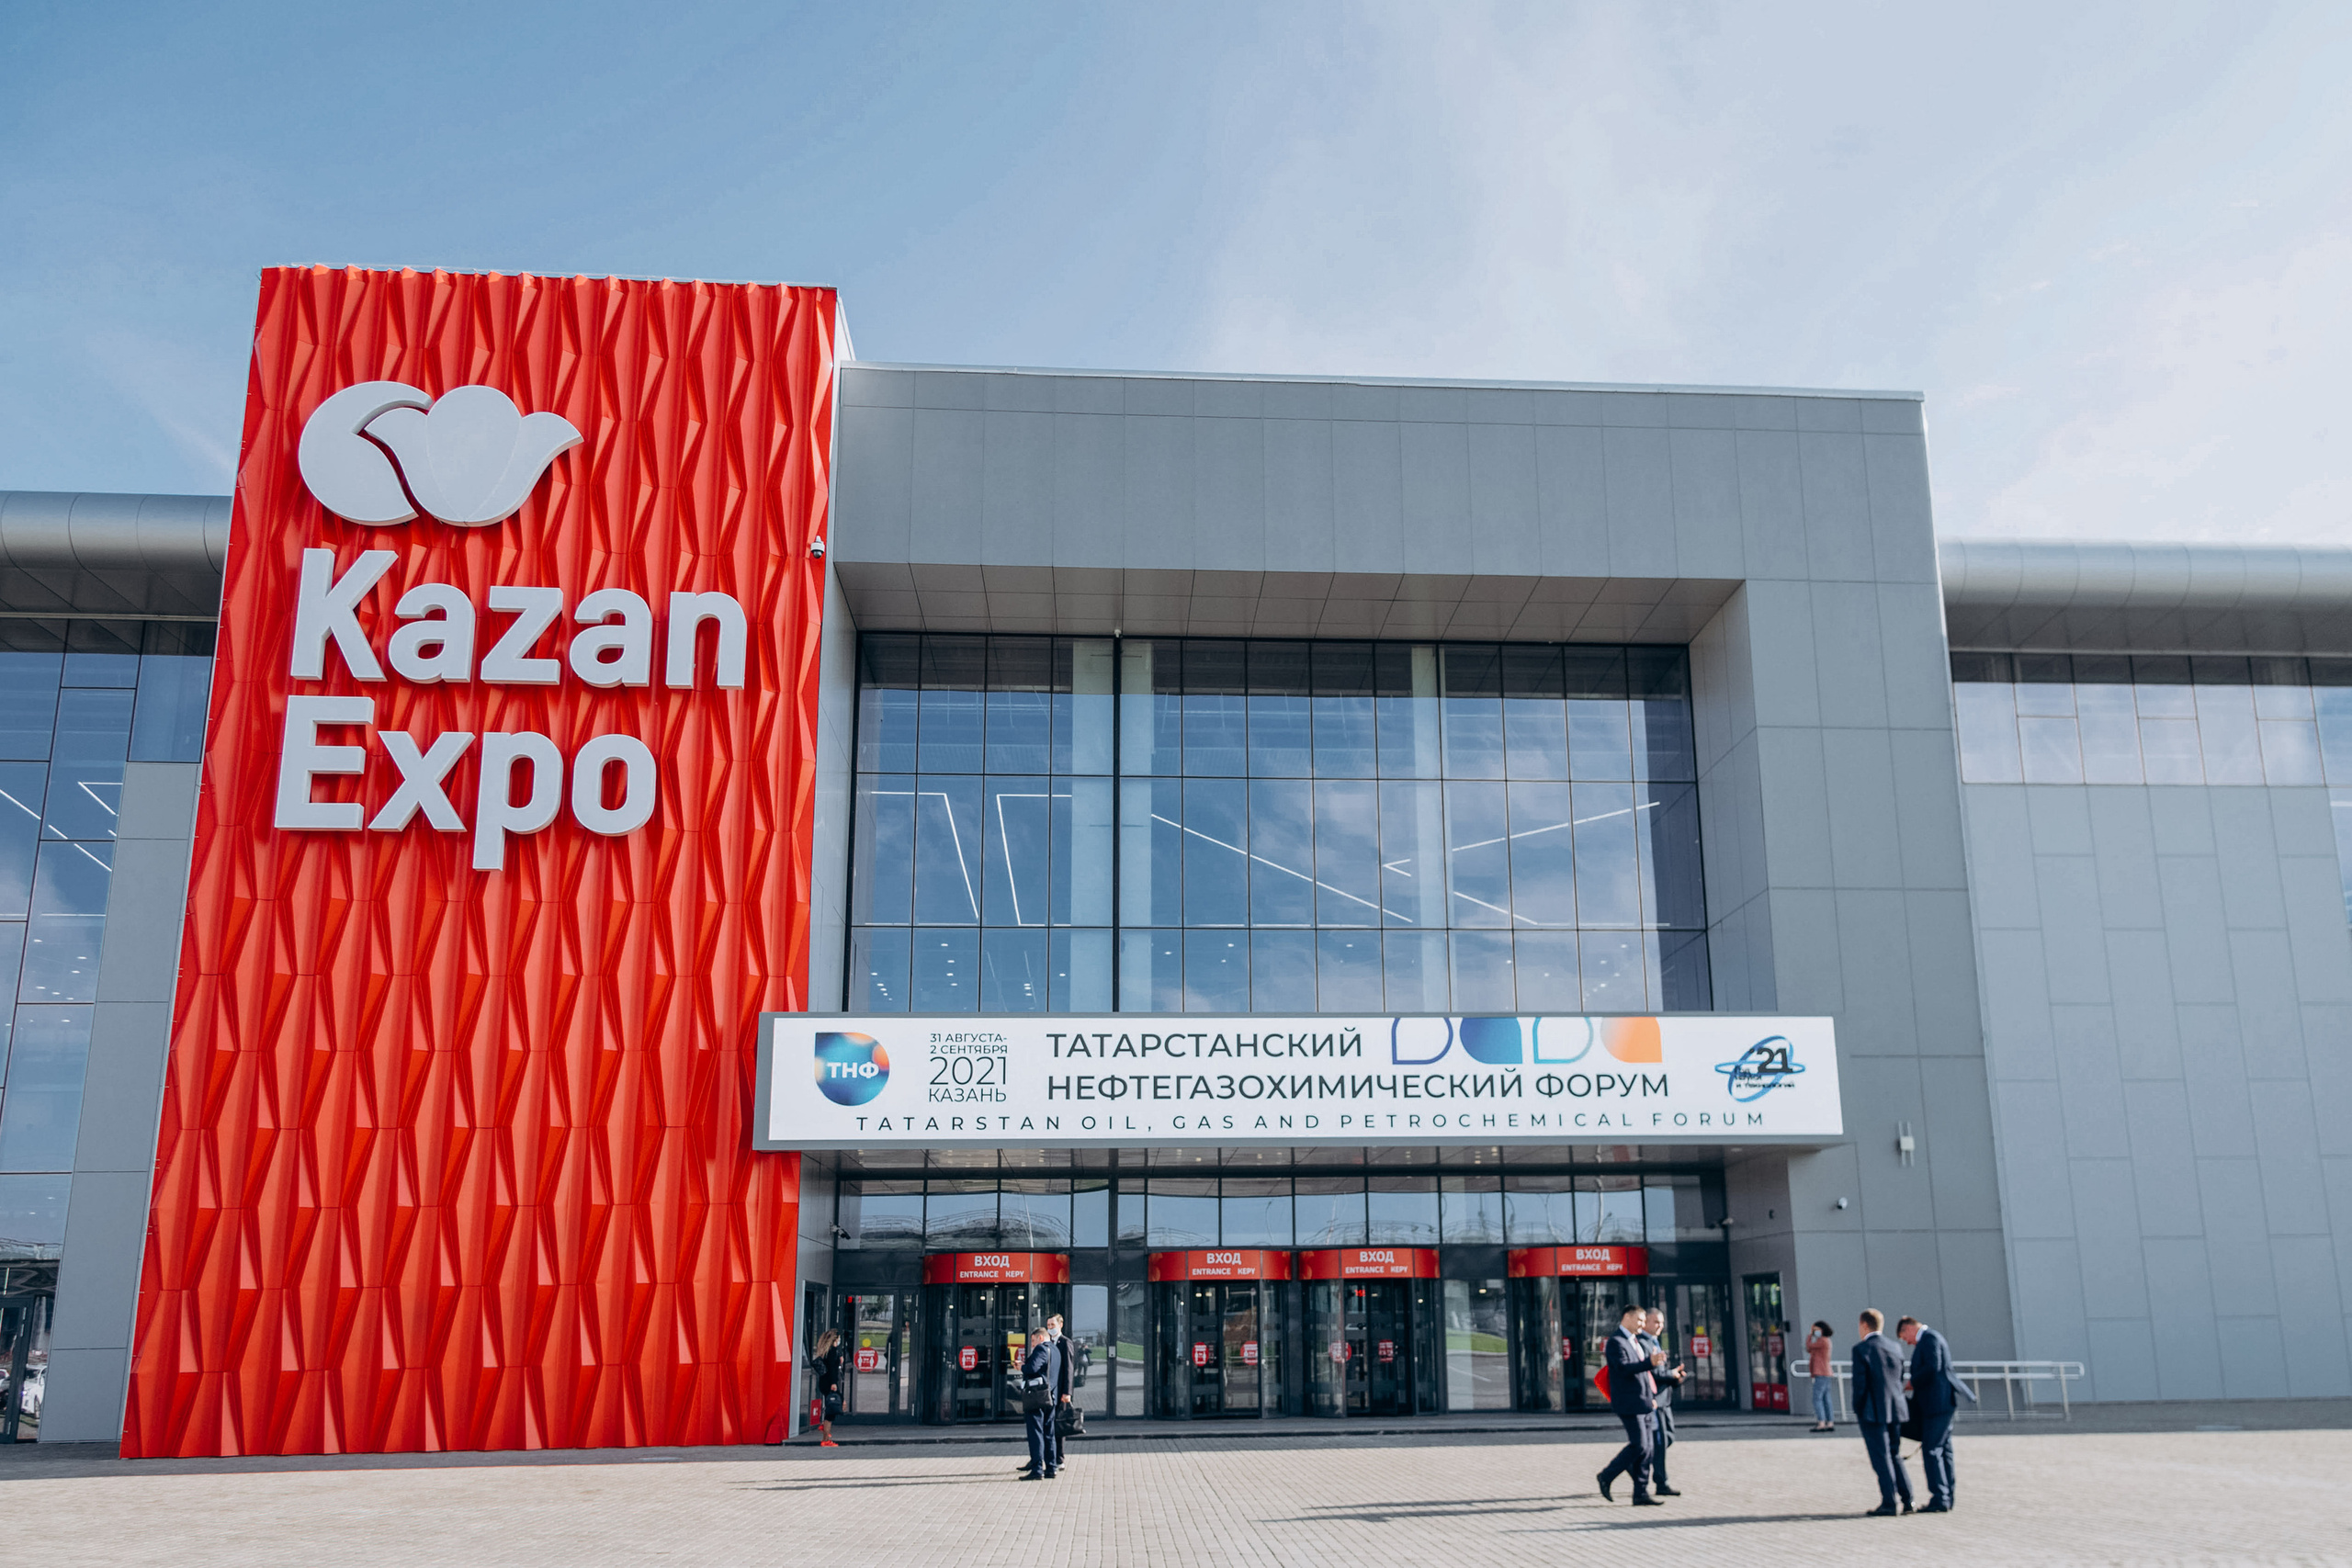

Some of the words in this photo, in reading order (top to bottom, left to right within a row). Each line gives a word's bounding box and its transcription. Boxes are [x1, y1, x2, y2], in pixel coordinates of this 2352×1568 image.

[290, 548, 747, 690] Kazan
[275, 695, 657, 872] Expo
[930, 1032, 942, 1043] 31
[1046, 1027, 1362, 1058] ТАТАРСТАНСКИЙ
[930, 1044, 937, 1055] 2
[940, 1044, 1008, 1055] СЕНТЯБРЯ
[827, 1061, 879, 1079] ТНФ
[929, 1055, 1007, 1086] 2021
[1047, 1067, 1522, 1101] НЕФТЕГАЗОХИМИЧЕСКИЙ
[1535, 1073, 1668, 1099] ФОРУМ
[928, 1087, 1007, 1103] КАЗАНЬ
[855, 1115, 1059, 1132] TATARSTAN
[1081, 1115, 1152, 1133] OIL,
[1172, 1114, 1234, 1130] GAS
[1254, 1114, 1319, 1129] AND
[1340, 1112, 1632, 1129] PETROCHEMICAL
[1652, 1112, 1763, 1126] FORUM
[1206, 1252, 1242, 1265] ВХОД
[1359, 1250, 1395, 1263] ВХОД
[1576, 1248, 1611, 1261] ВХОД
[974, 1255, 1011, 1268] ВХОД
[1561, 1263, 1601, 1271] ENTRANCE
[959, 1270, 999, 1279] ENTRANCE
[1192, 1267, 1231, 1275] ENTRANCE
[1345, 1266, 1385, 1274] ENTRANCE
